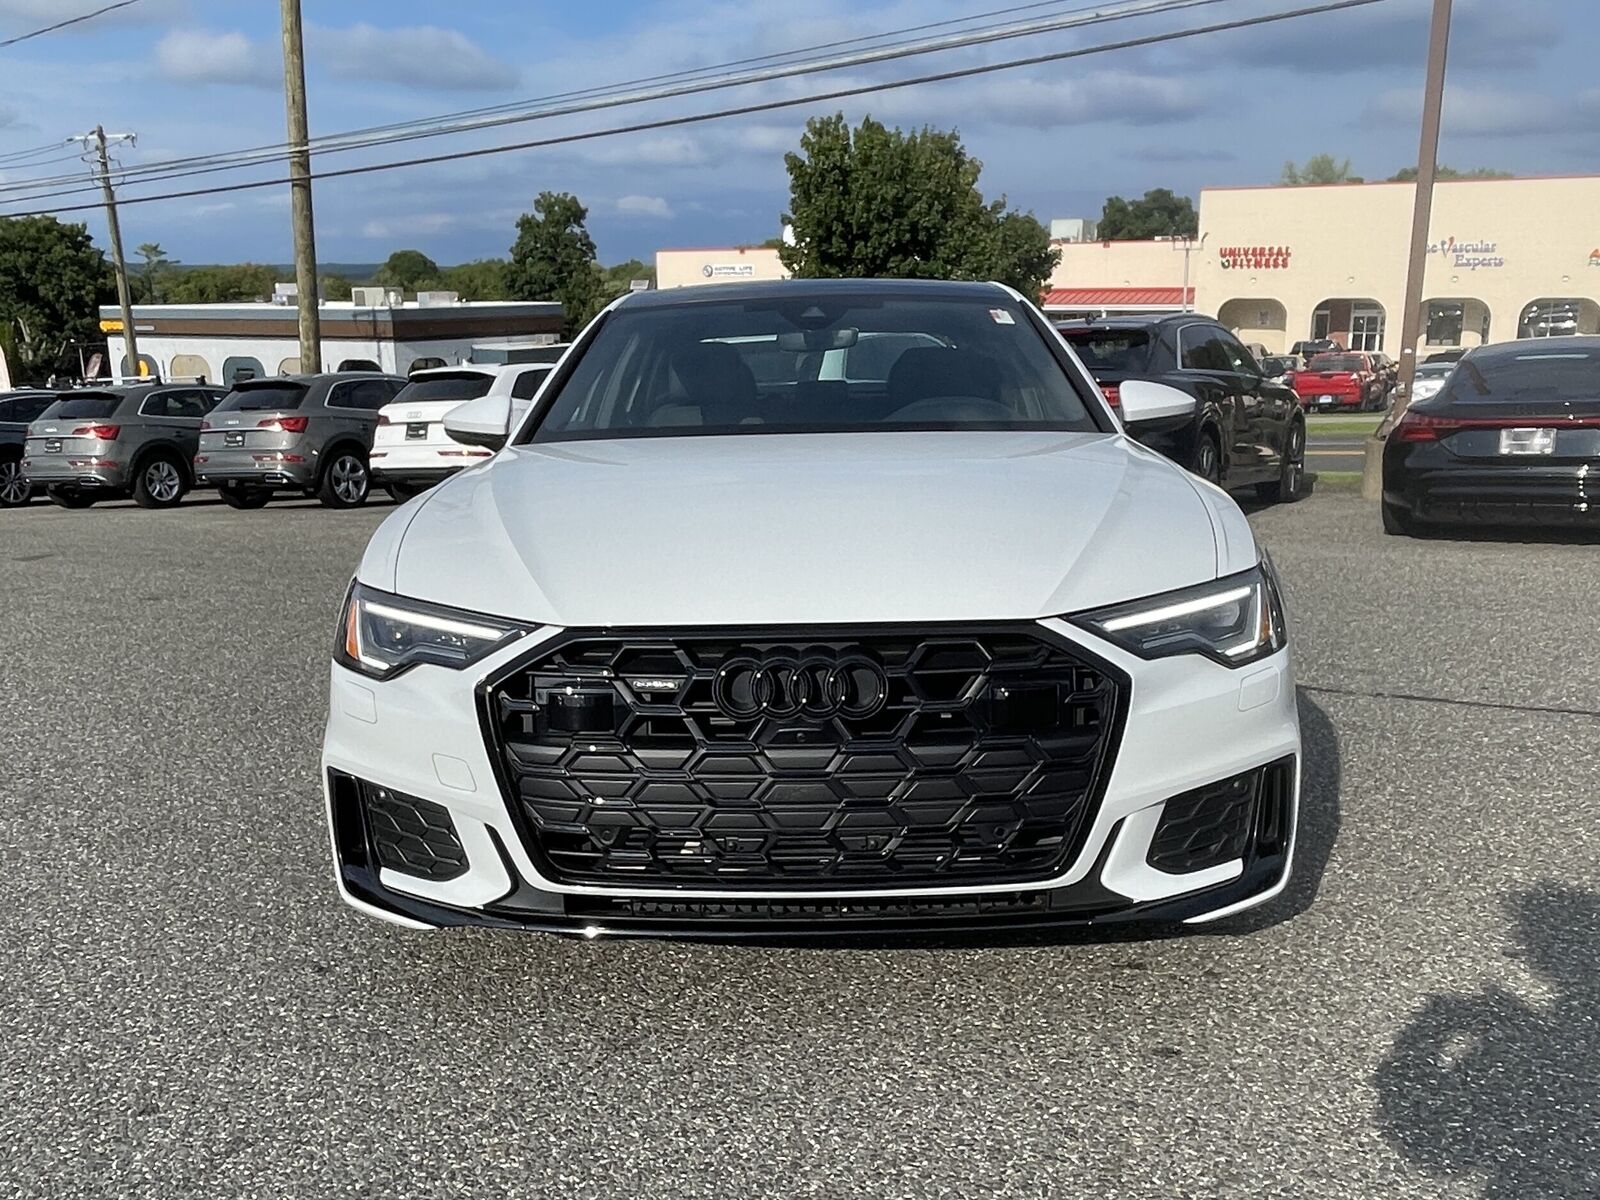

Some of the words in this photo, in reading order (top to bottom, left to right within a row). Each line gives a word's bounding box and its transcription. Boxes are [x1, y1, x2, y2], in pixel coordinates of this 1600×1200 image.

[1219, 246, 1292, 258] UNIVERSAL
[1440, 235, 1497, 258] Vascular
[1231, 257, 1289, 269] FITNESS
[1453, 254, 1504, 271] Experts
